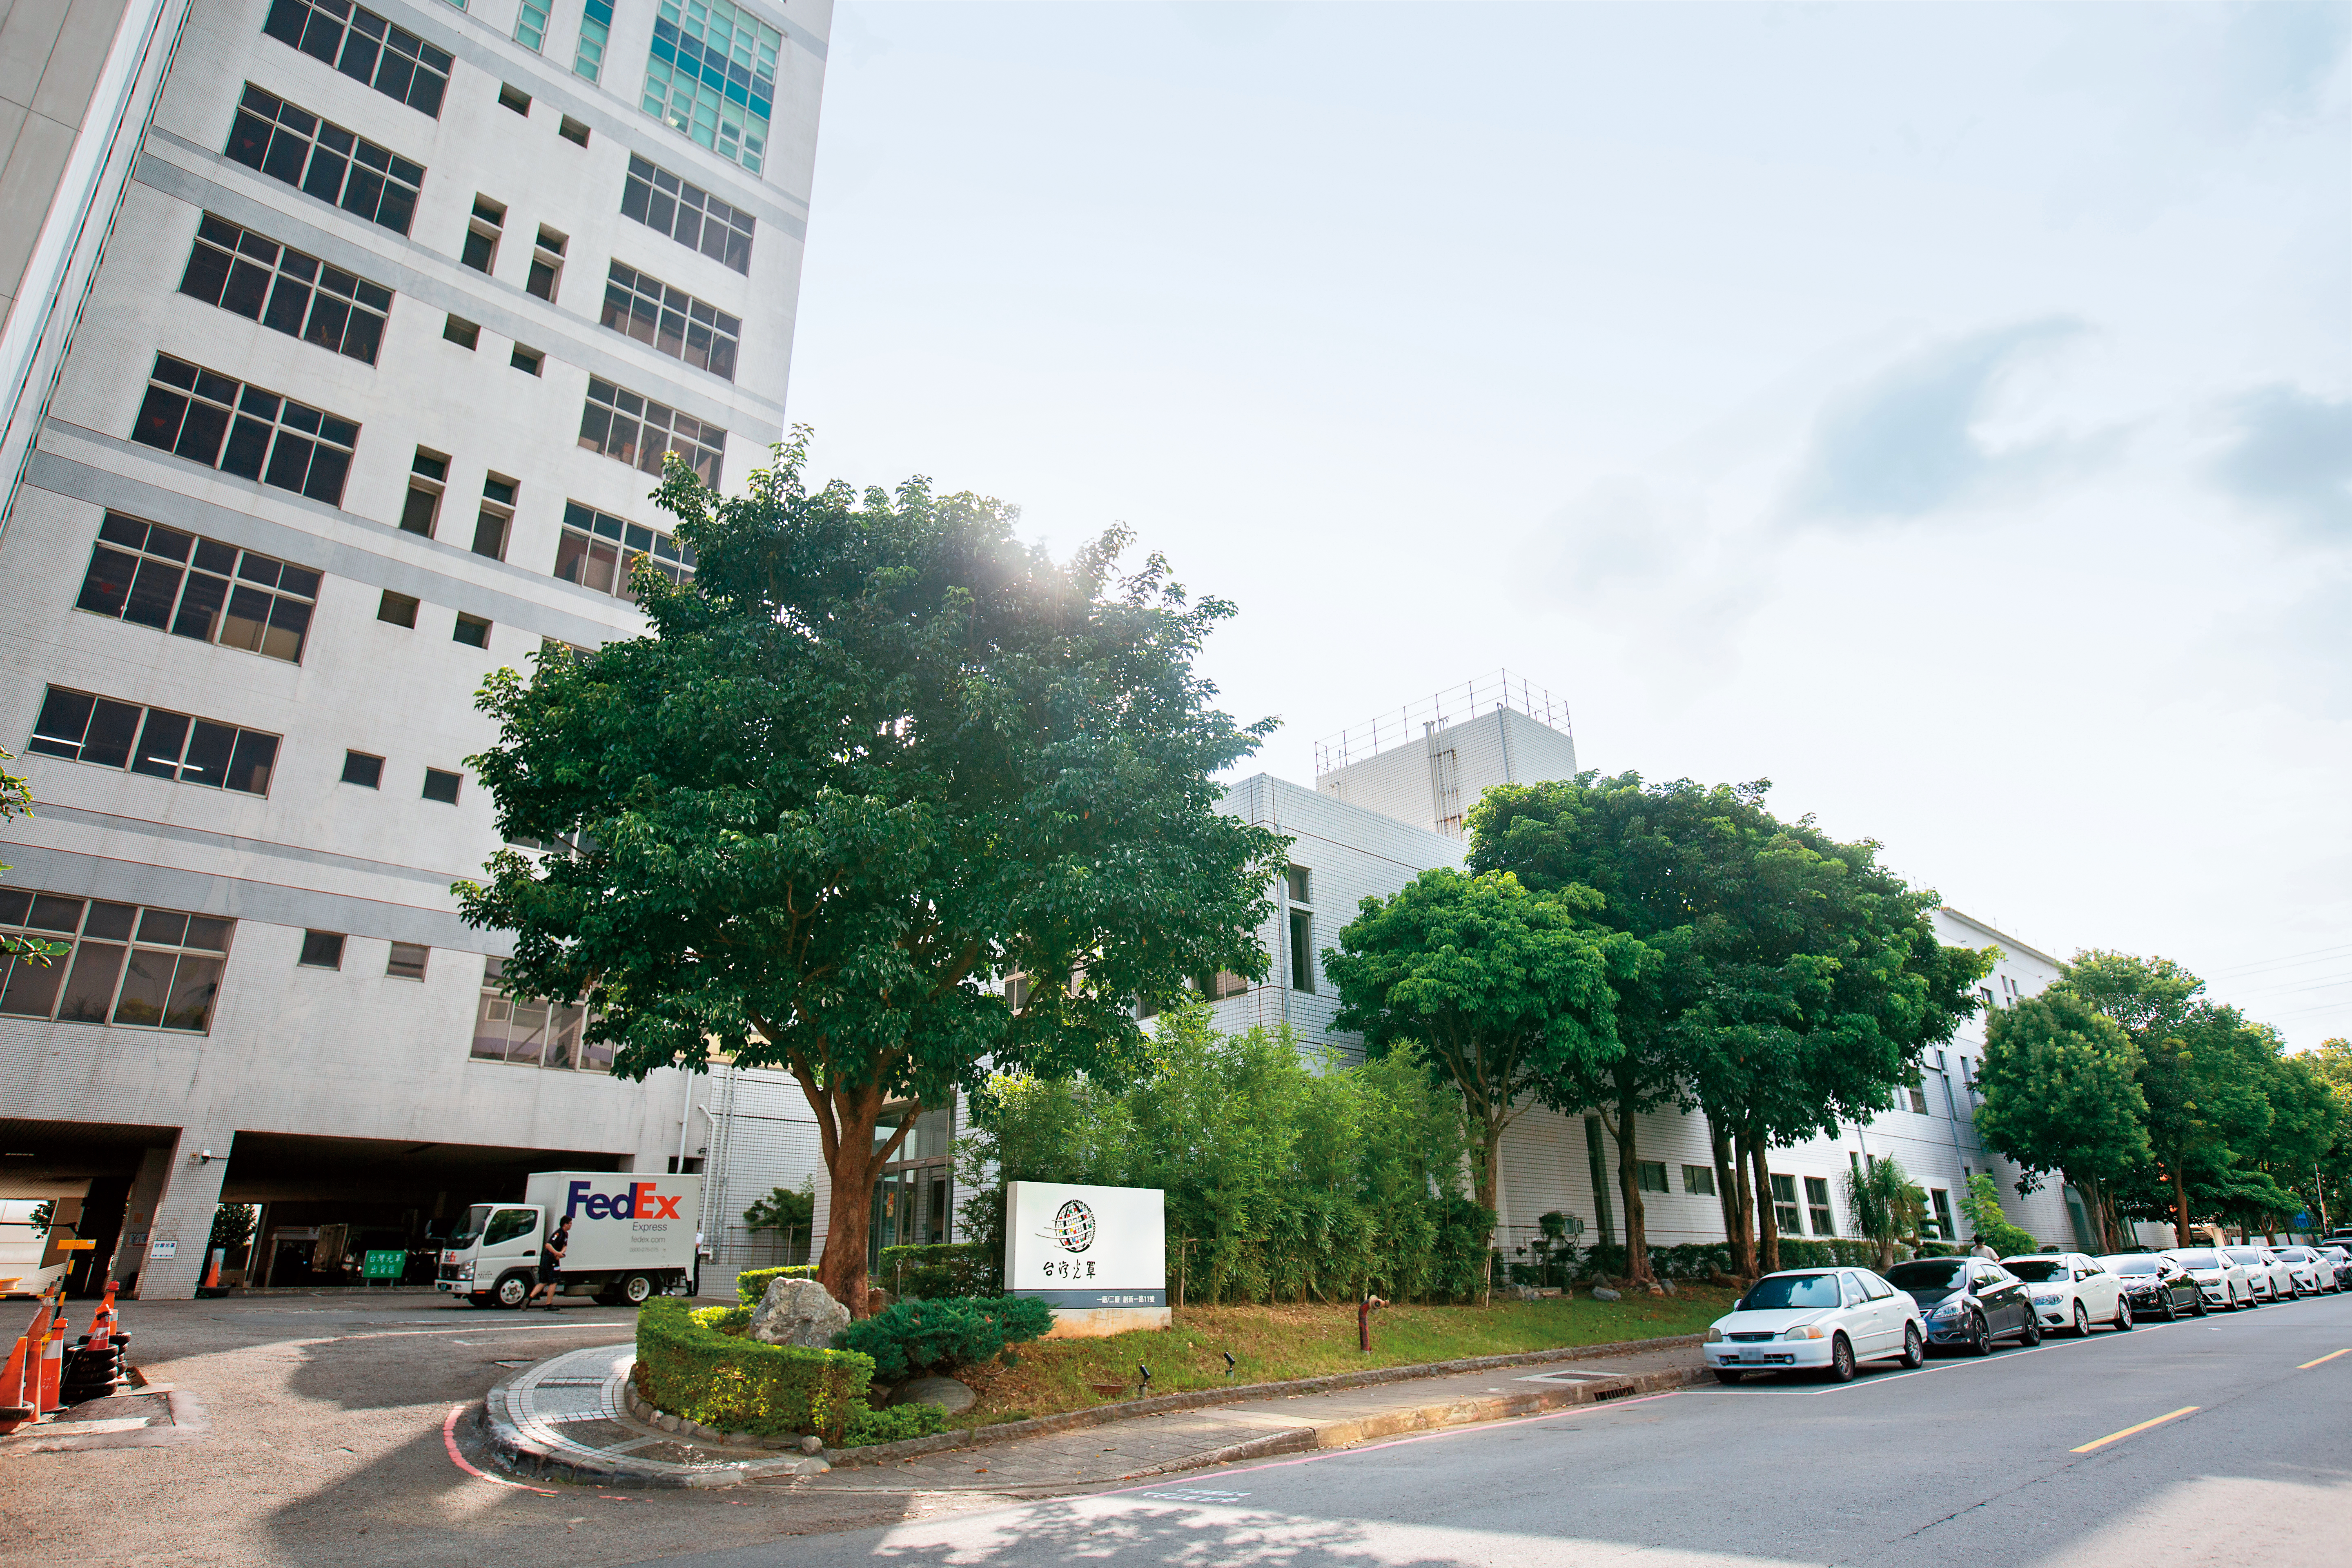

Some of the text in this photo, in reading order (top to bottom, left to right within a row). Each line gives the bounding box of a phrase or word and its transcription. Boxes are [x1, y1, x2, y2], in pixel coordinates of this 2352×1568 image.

[566, 1181, 682, 1220] FedEx
[1084, 1203, 1092, 1213] MASK
[633, 1222, 667, 1233] Express
[370, 1254, 402, 1263] 台灣光罩
[1043, 1259, 1096, 1279] 台灣光罩
